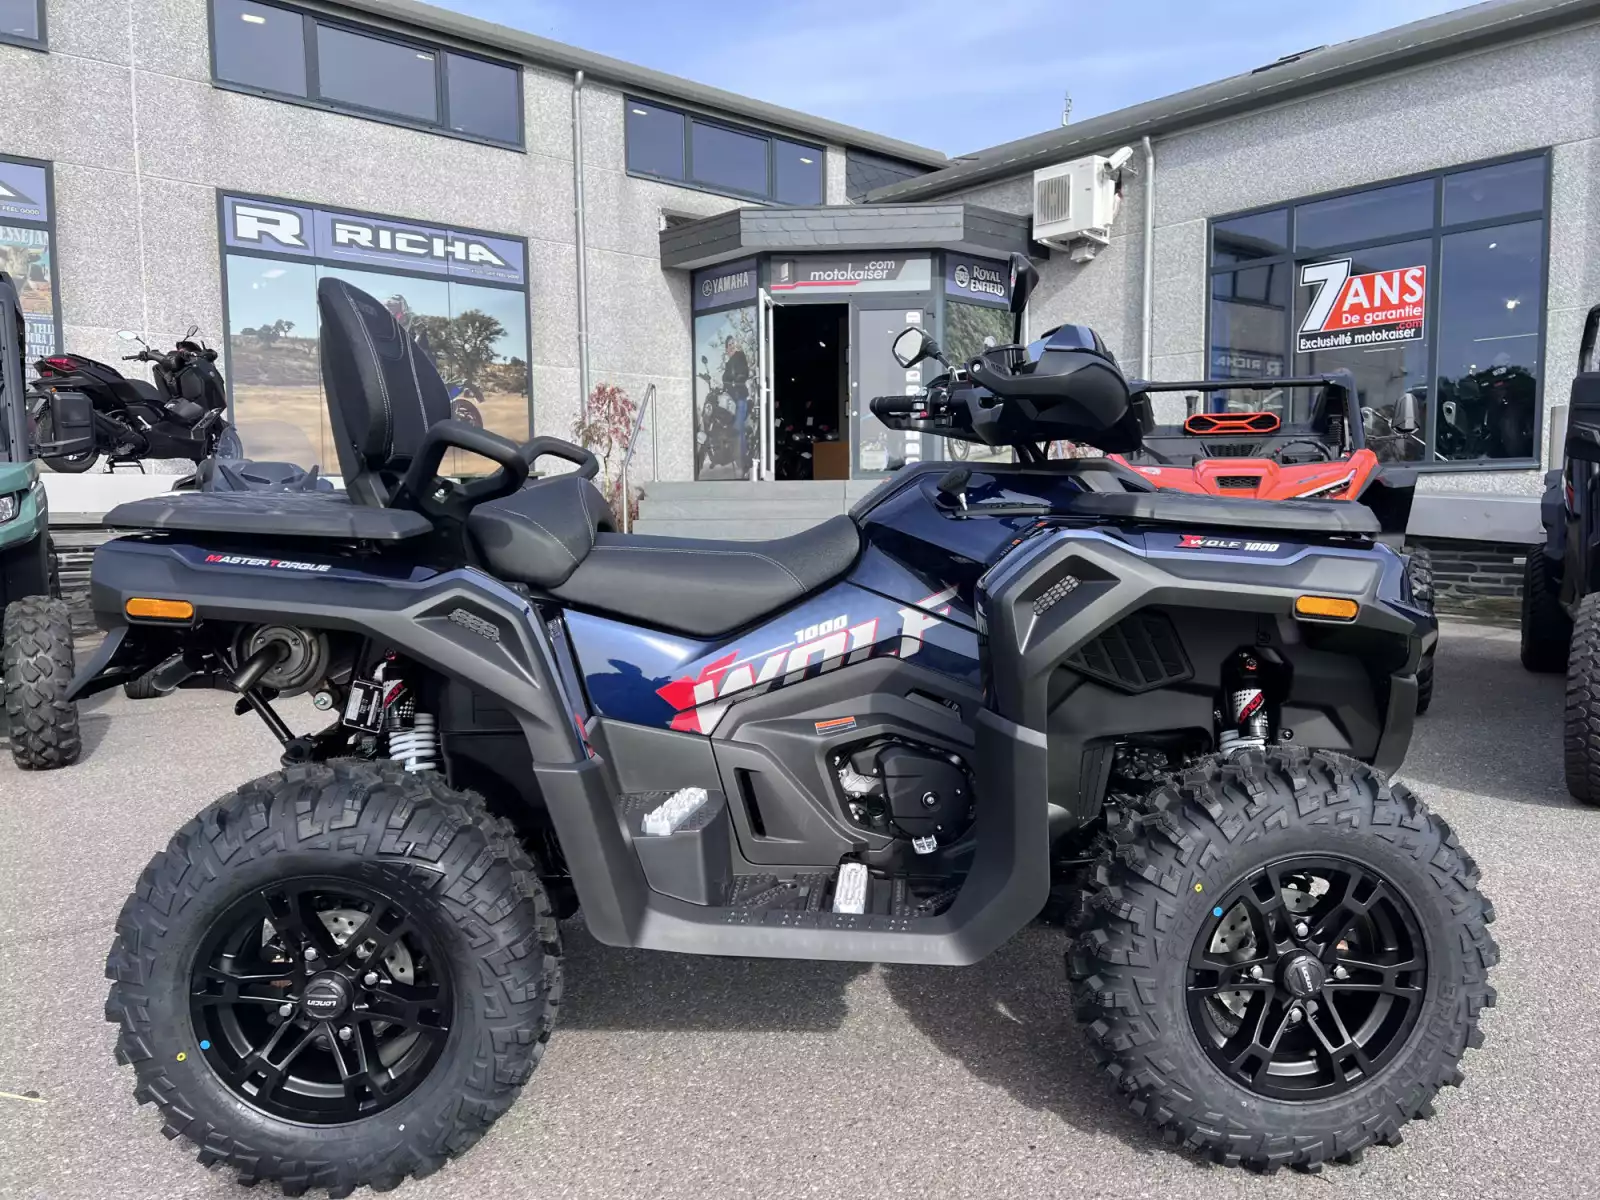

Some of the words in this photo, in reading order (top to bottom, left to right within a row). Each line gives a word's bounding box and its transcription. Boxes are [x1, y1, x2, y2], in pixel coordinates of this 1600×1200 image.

[2, 205, 19, 213] FEEL
[20, 208, 40, 216] GOOD
[235, 204, 305, 247] R
[335, 222, 506, 267] RICHA
[810, 262, 888, 281] motokaiser
[865, 260, 896, 271] .com
[973, 265, 1001, 282] ROYAL
[712, 271, 749, 294] YAMAHA
[970, 279, 1005, 297] ENFIELD
[1301, 258, 1351, 332] 7
[1342, 268, 1423, 311] ANS
[1342, 313, 1360, 325] De
[1364, 304, 1422, 325] garantie
[1300, 332, 1352, 350] Exclusivité
[1354, 328, 1416, 344] motokaiser
[1243, 542, 1280, 552] 1000
[205, 554, 269, 566] MASTER
[270, 560, 332, 572] TORQUE
[795, 614, 848, 643] 1000
